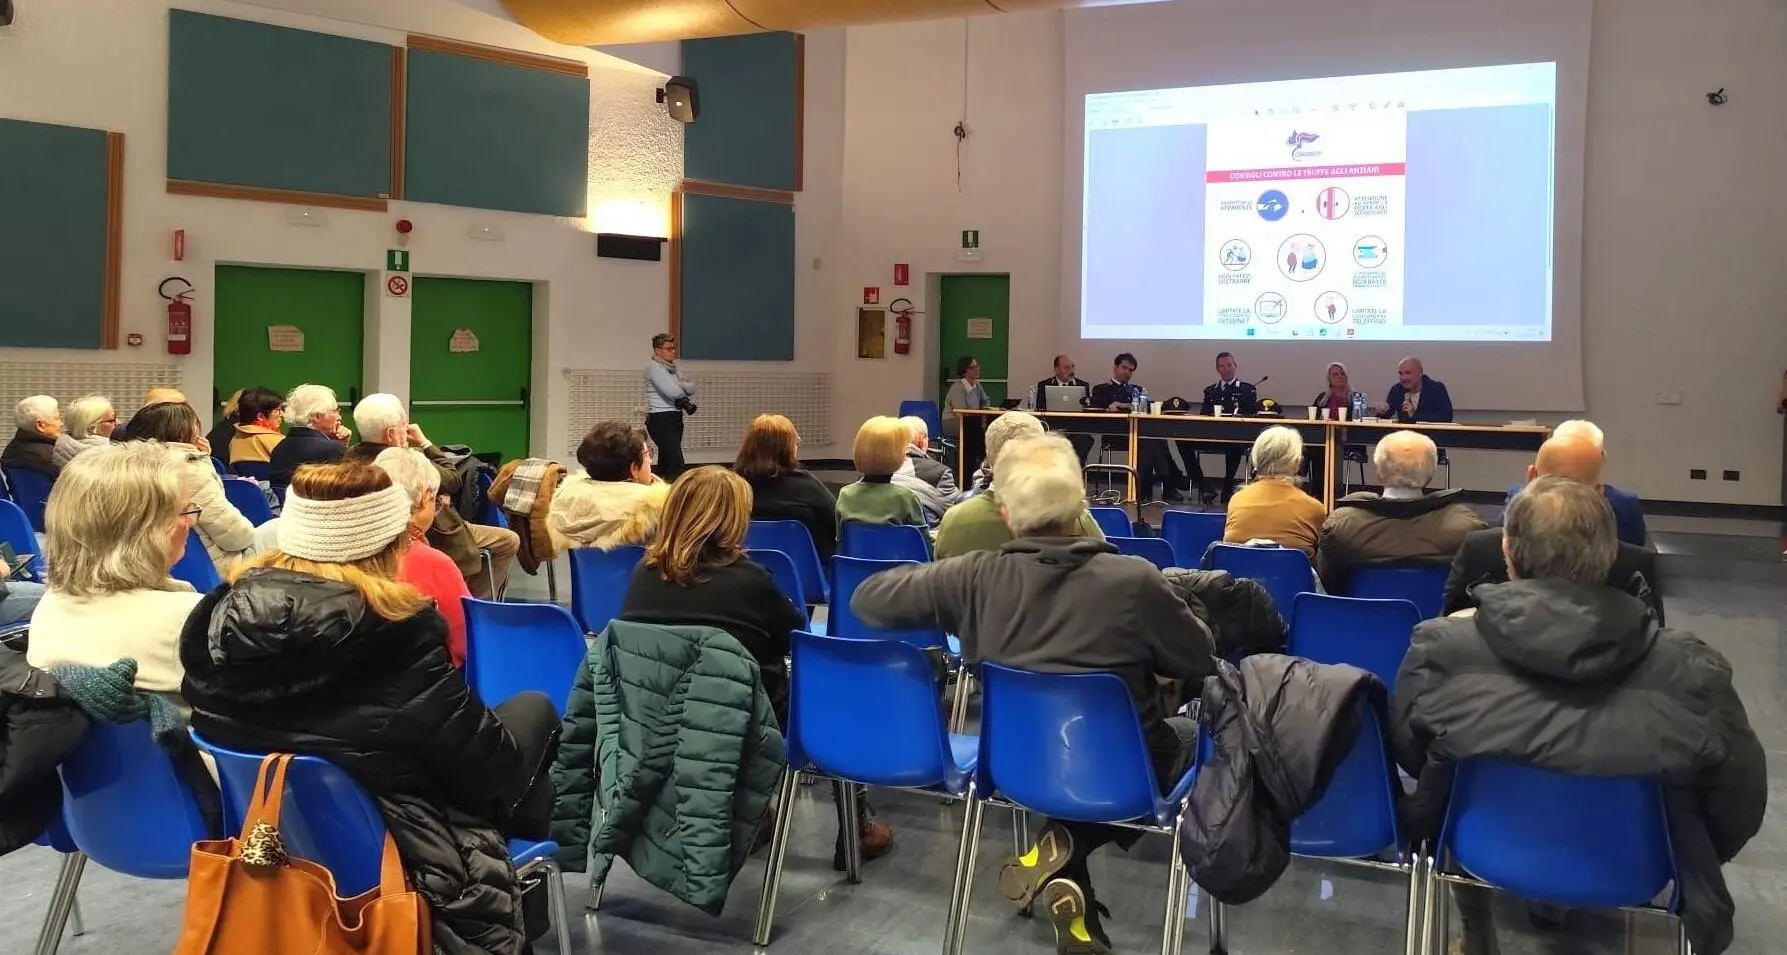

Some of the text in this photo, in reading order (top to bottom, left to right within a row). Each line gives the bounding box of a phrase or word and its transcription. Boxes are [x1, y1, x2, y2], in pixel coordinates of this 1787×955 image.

[1230, 172, 1263, 180] CONSIGLI
[1303, 169, 1330, 177] TRUFFE
[1348, 167, 1380, 175] ANZIANI
